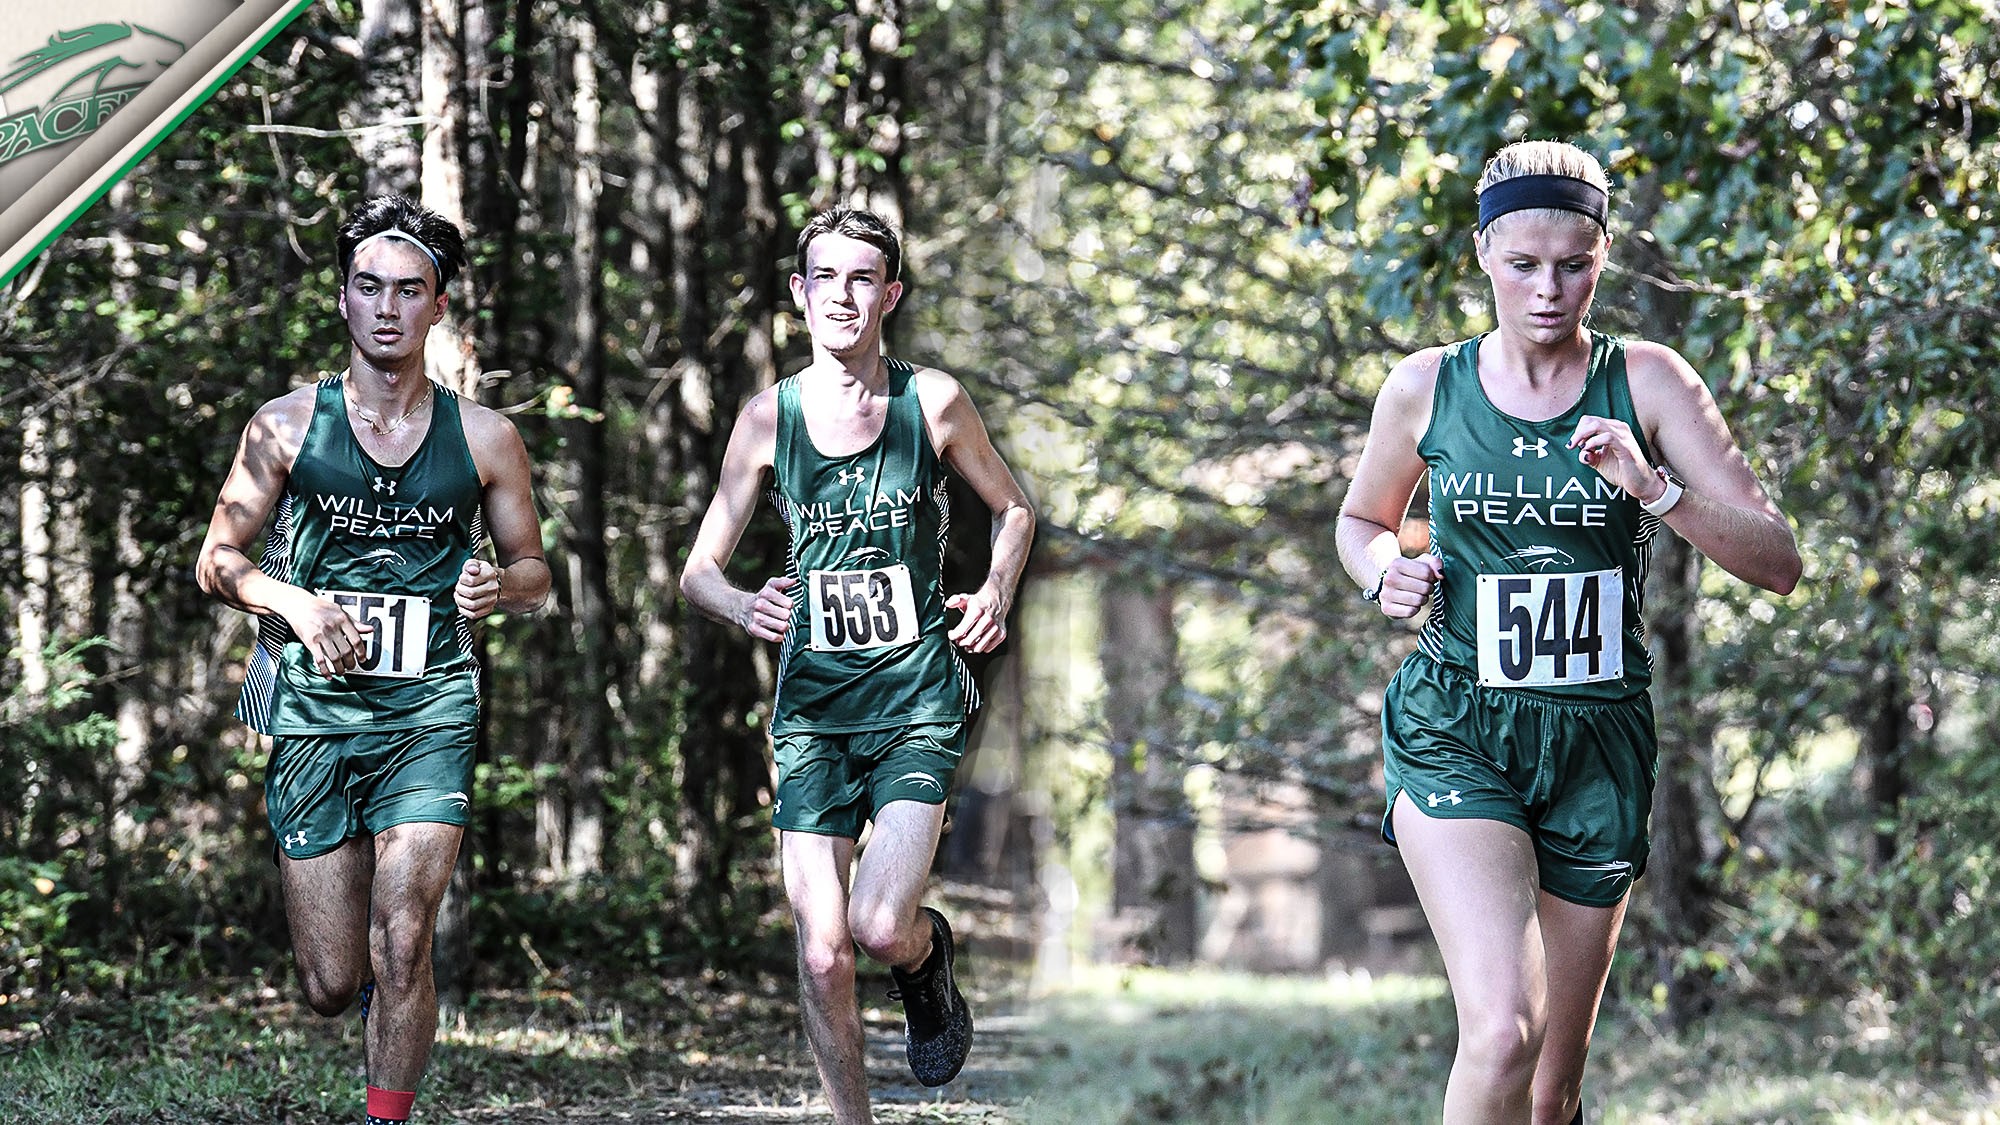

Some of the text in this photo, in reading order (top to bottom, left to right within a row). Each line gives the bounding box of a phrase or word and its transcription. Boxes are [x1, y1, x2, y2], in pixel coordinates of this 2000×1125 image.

[1439, 472, 1627, 501] WILLIAM
[316, 493, 454, 524] WILLIAM
[794, 485, 921, 520] WILLIAM
[1453, 499, 1607, 527] PEACE
[329, 515, 437, 540] PEACE
[809, 508, 909, 538] PEACE
[820, 571, 899, 647] 553
[333, 594, 407, 673] 51
[1498, 575, 1603, 681] 544
